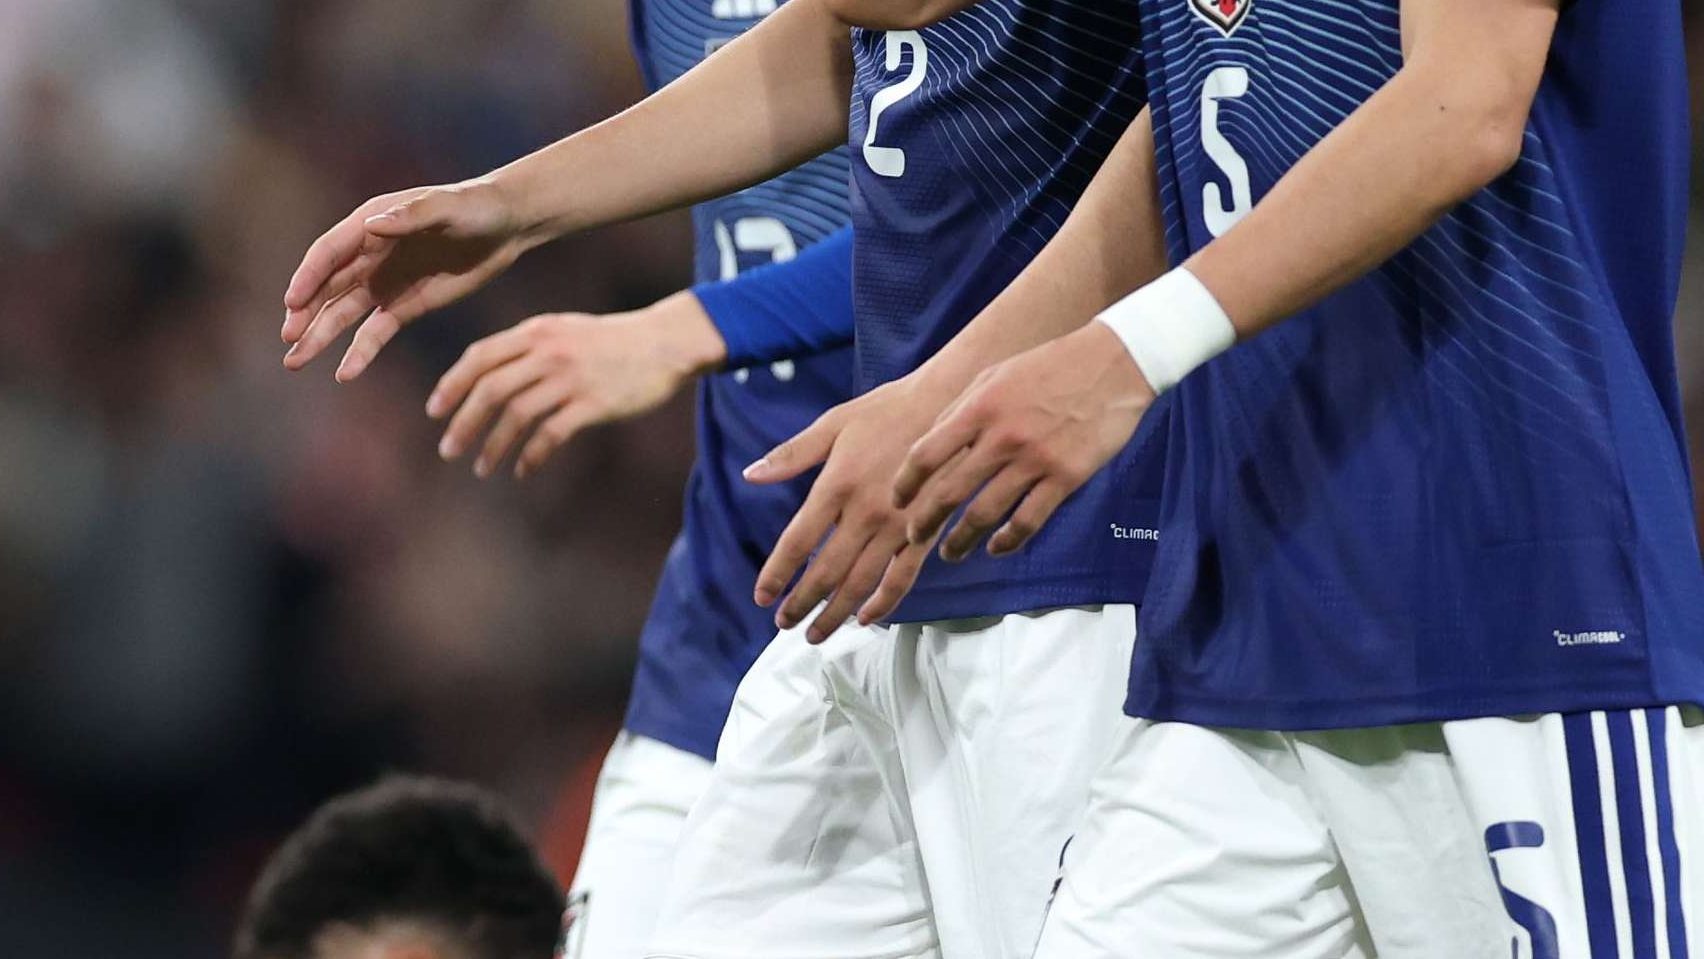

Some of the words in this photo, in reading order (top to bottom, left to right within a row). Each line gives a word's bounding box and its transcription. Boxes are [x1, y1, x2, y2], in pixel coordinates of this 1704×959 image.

[863, 30, 928, 178] 2
[1201, 67, 1253, 239] 5
[1113, 527, 1160, 541] CLIMAC
[1484, 821, 1561, 959] 5
